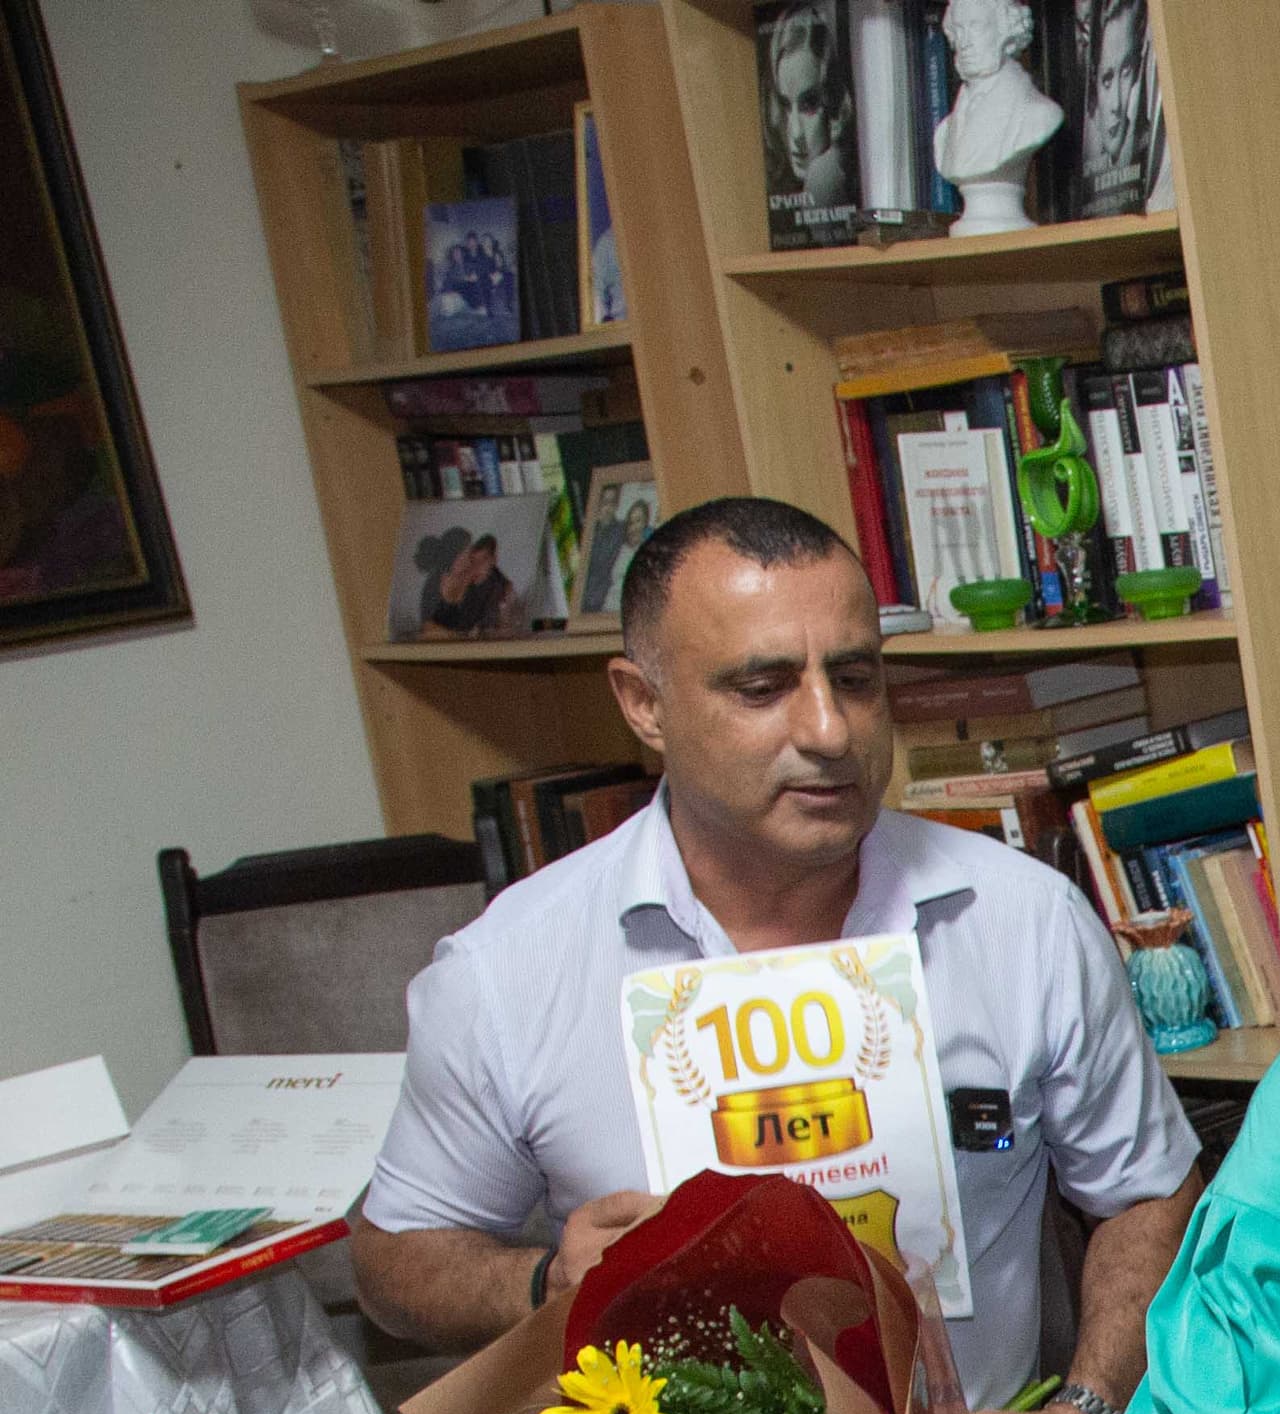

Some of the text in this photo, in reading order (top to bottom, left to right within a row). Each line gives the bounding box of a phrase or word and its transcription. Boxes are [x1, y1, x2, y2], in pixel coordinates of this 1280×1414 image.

[695, 989, 846, 1081] 100
[265, 1072, 343, 1090] merci
[754, 1111, 836, 1149] Лет
[791, 1153, 889, 1186] илеем!
